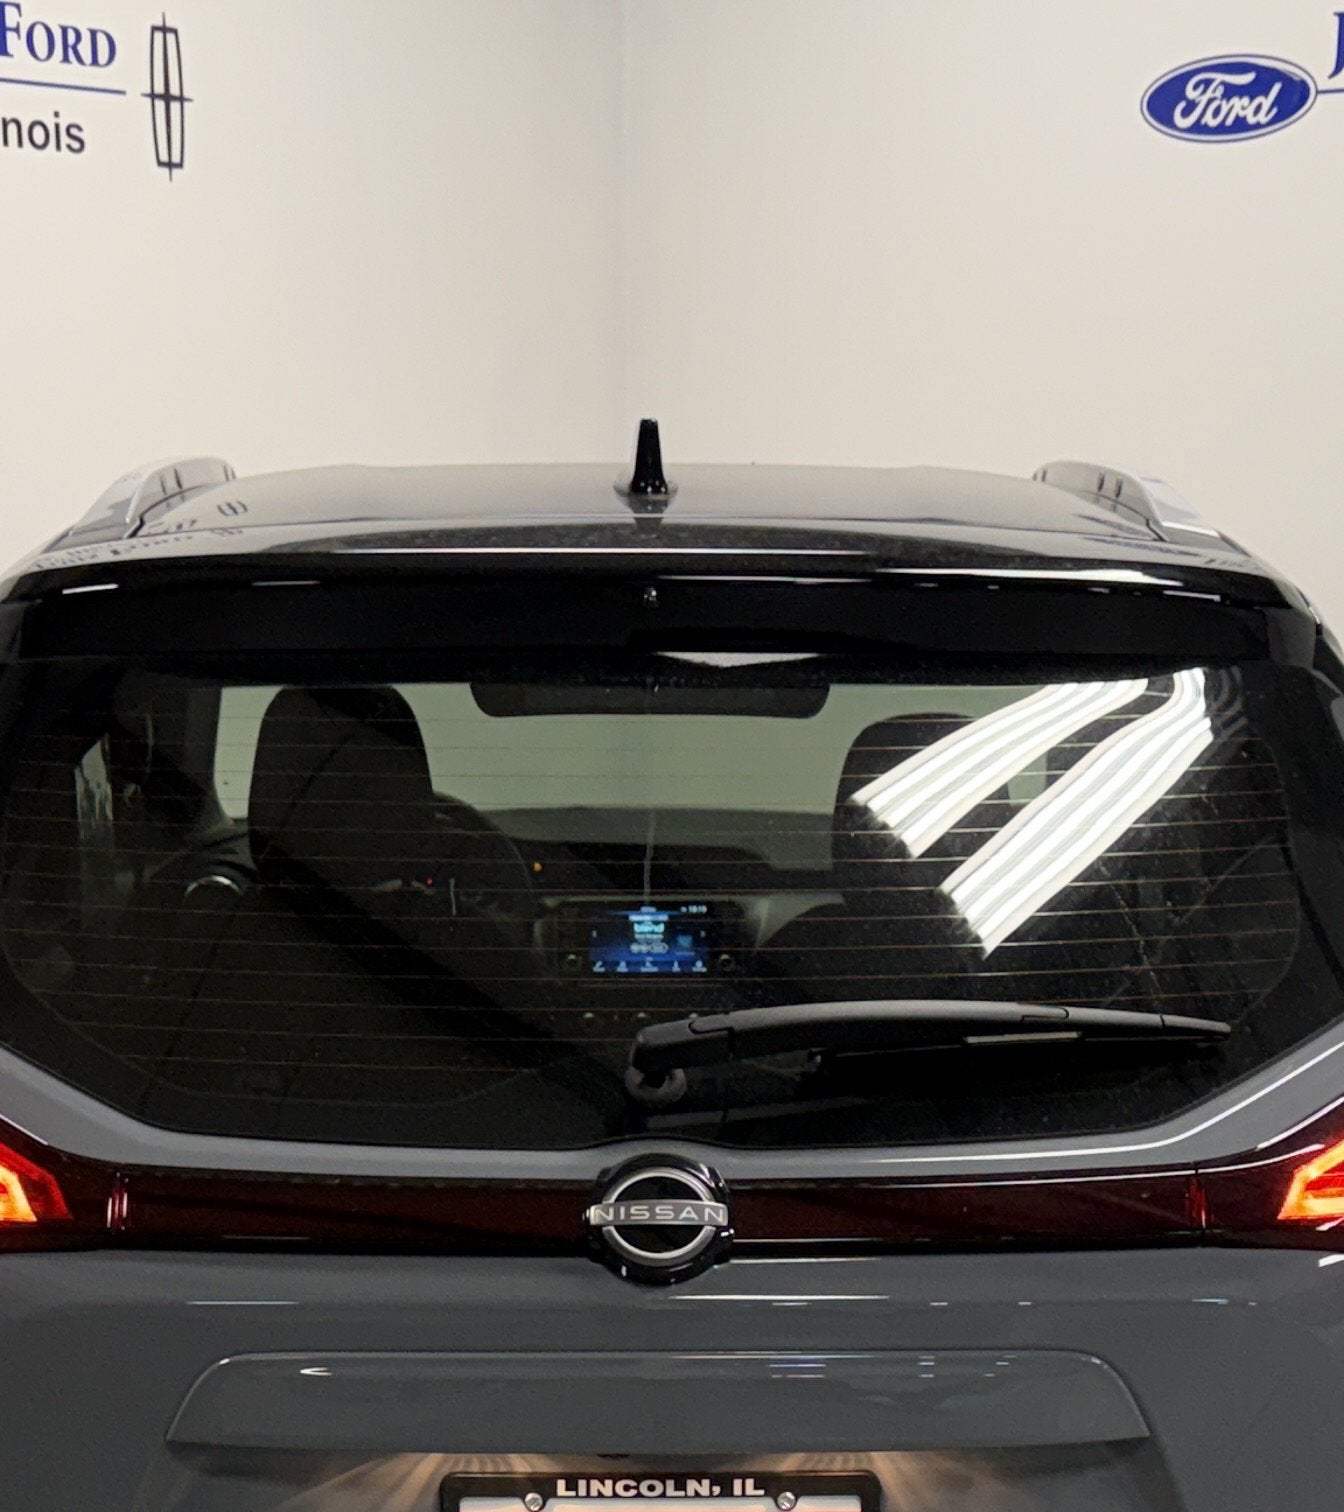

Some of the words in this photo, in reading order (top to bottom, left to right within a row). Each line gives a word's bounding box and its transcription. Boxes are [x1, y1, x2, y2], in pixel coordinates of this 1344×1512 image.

[1173, 71, 1278, 129] Ford
[595, 1204, 724, 1223] NISSAN
[557, 1478, 721, 1498] LINCOLN,
[733, 1479, 765, 1496] IL
